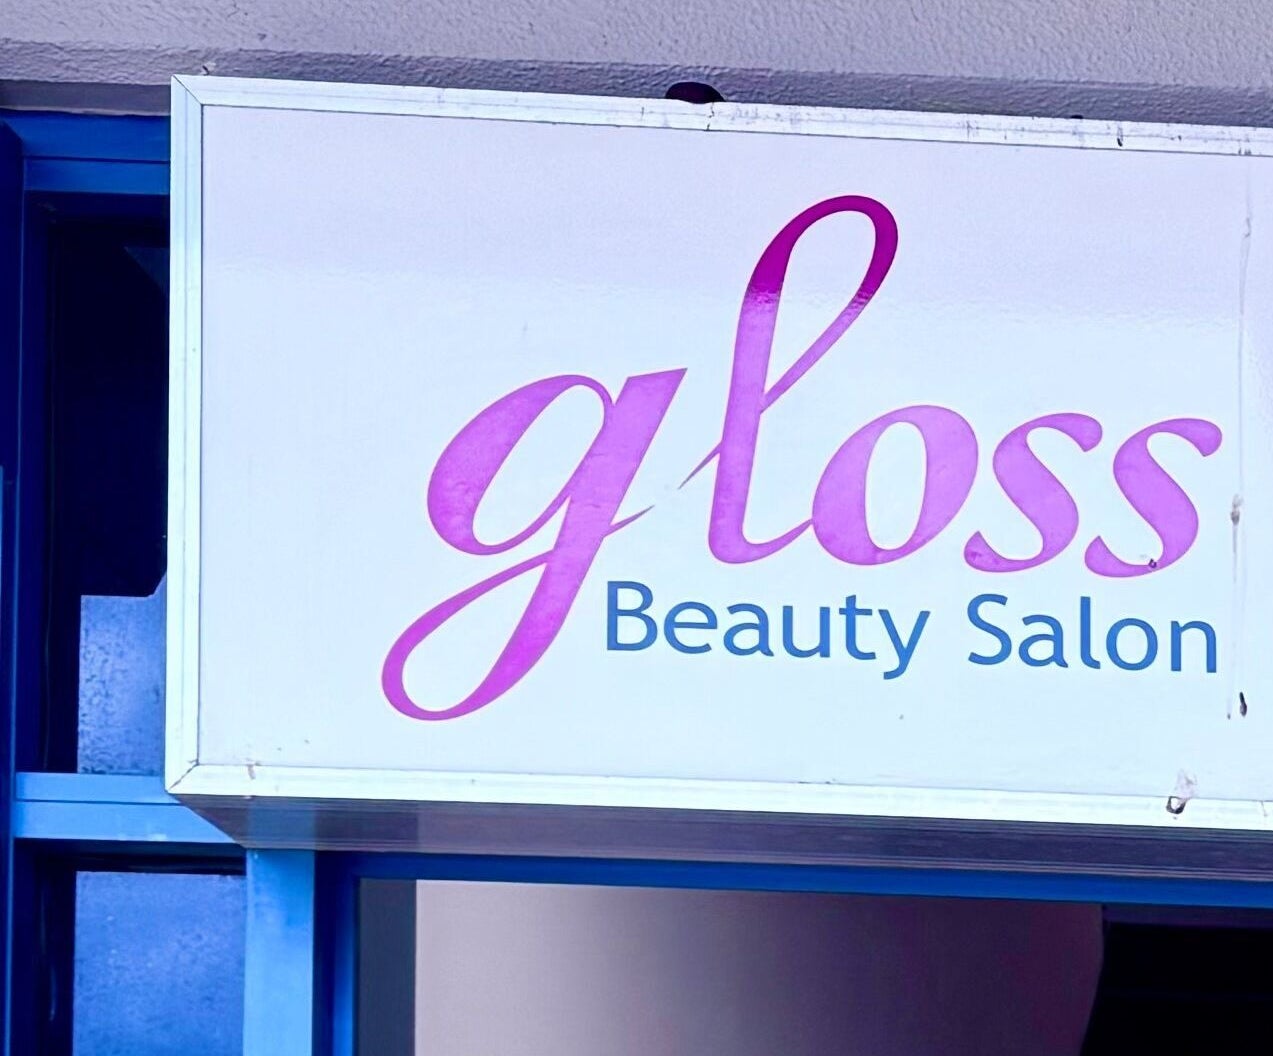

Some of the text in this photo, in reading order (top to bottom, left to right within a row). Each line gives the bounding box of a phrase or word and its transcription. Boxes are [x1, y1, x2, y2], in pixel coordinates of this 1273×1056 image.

[381, 194, 1222, 721] gloss
[606, 580, 1218, 681] Beauty Salon
